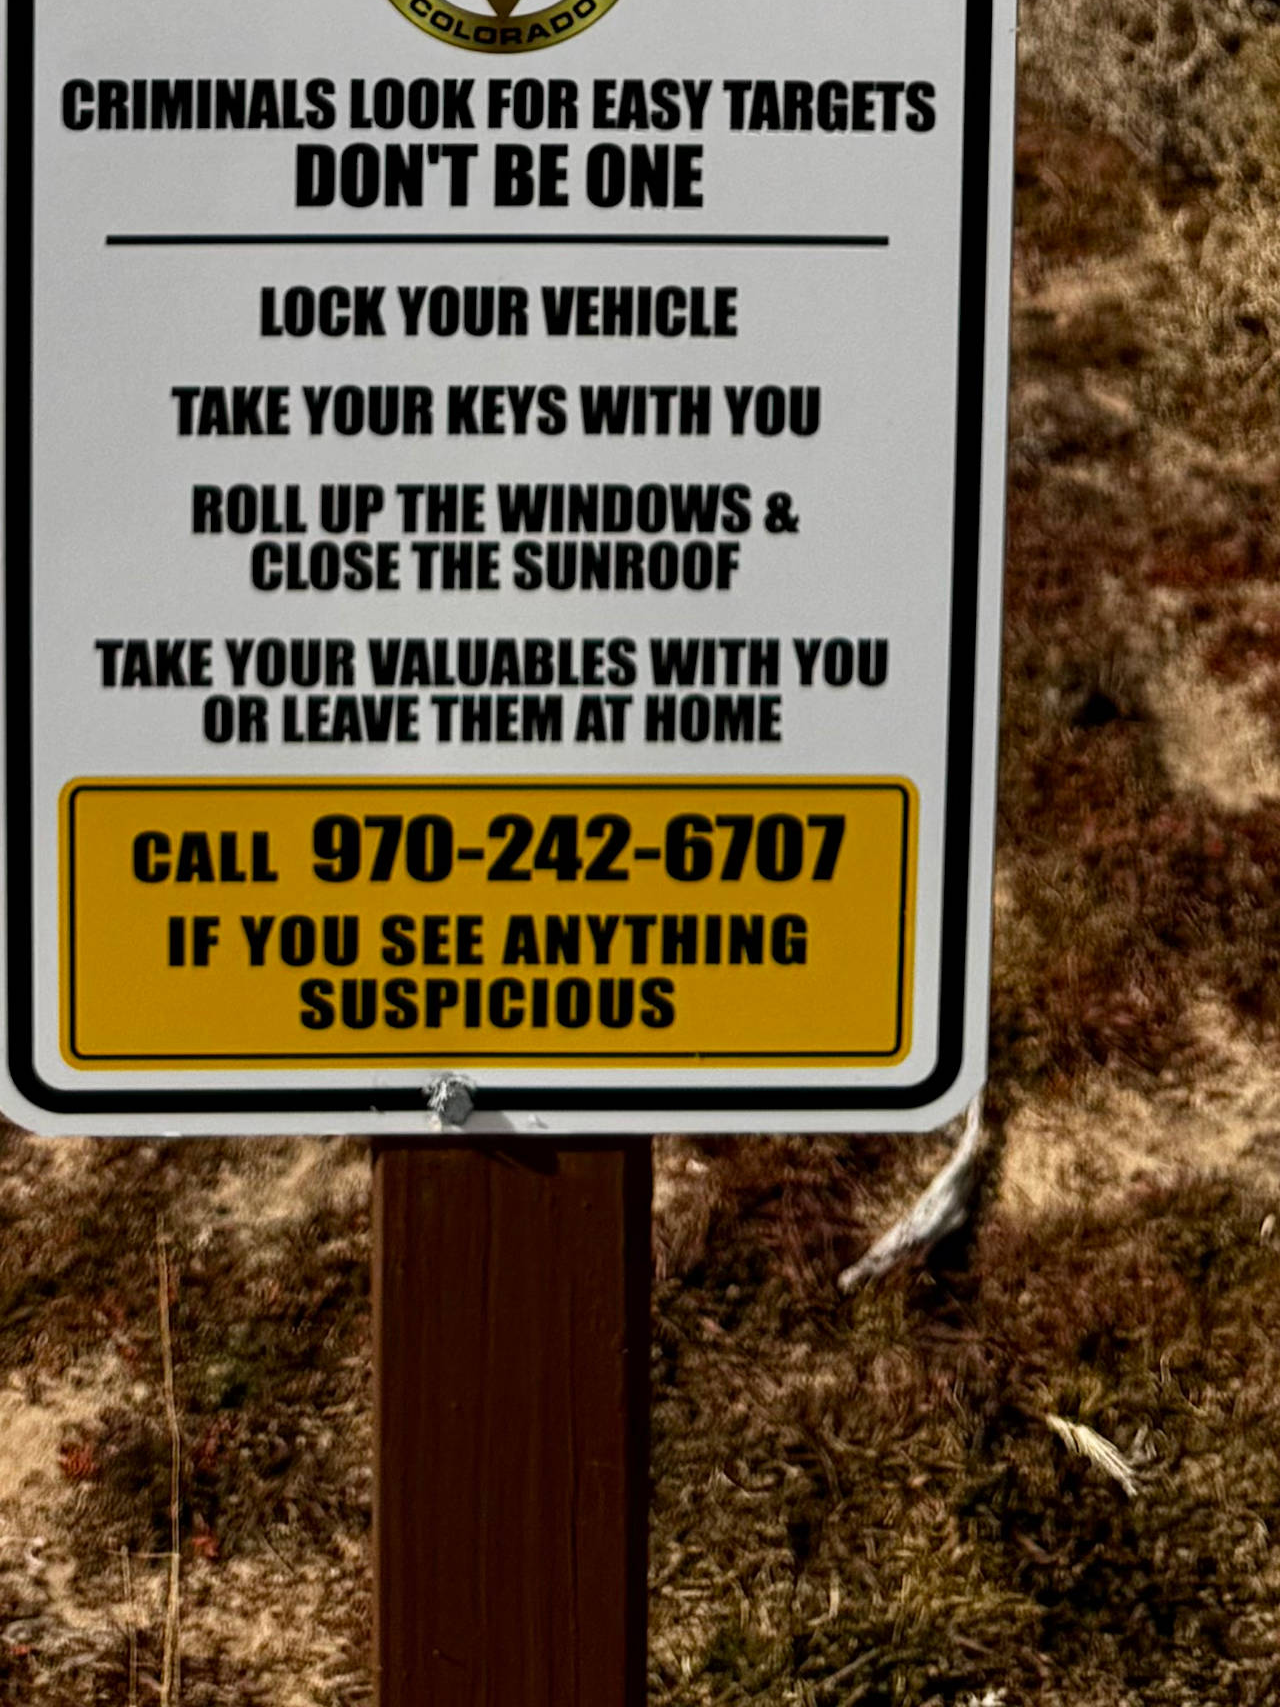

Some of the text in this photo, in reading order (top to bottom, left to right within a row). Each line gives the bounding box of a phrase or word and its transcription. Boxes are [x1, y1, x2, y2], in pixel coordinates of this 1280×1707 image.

[61, 78, 937, 131] CRIMINALS LOOK FOR EASY TARGETS
[295, 143, 705, 208] DON'T BE ONE
[260, 285, 739, 337] LOCK YOUR VEHICLE
[172, 385, 821, 437] TAKE YOUR KEYS WITH YOU
[192, 484, 800, 534] ROLL UP THE WINDOWS &
[250, 542, 741, 592] CLOSE THE SUNROOF
[95, 638, 889, 688] TAKE YOUR VALUABLES WITH YOU
[202, 695, 782, 745] OR LEAVE THEM AT HOME
[131, 813, 846, 884] CALL 970-242-6707
[167, 916, 809, 968] IF YOU SEE ANYTHING
[299, 978, 677, 1030] SUSPICIOUS
